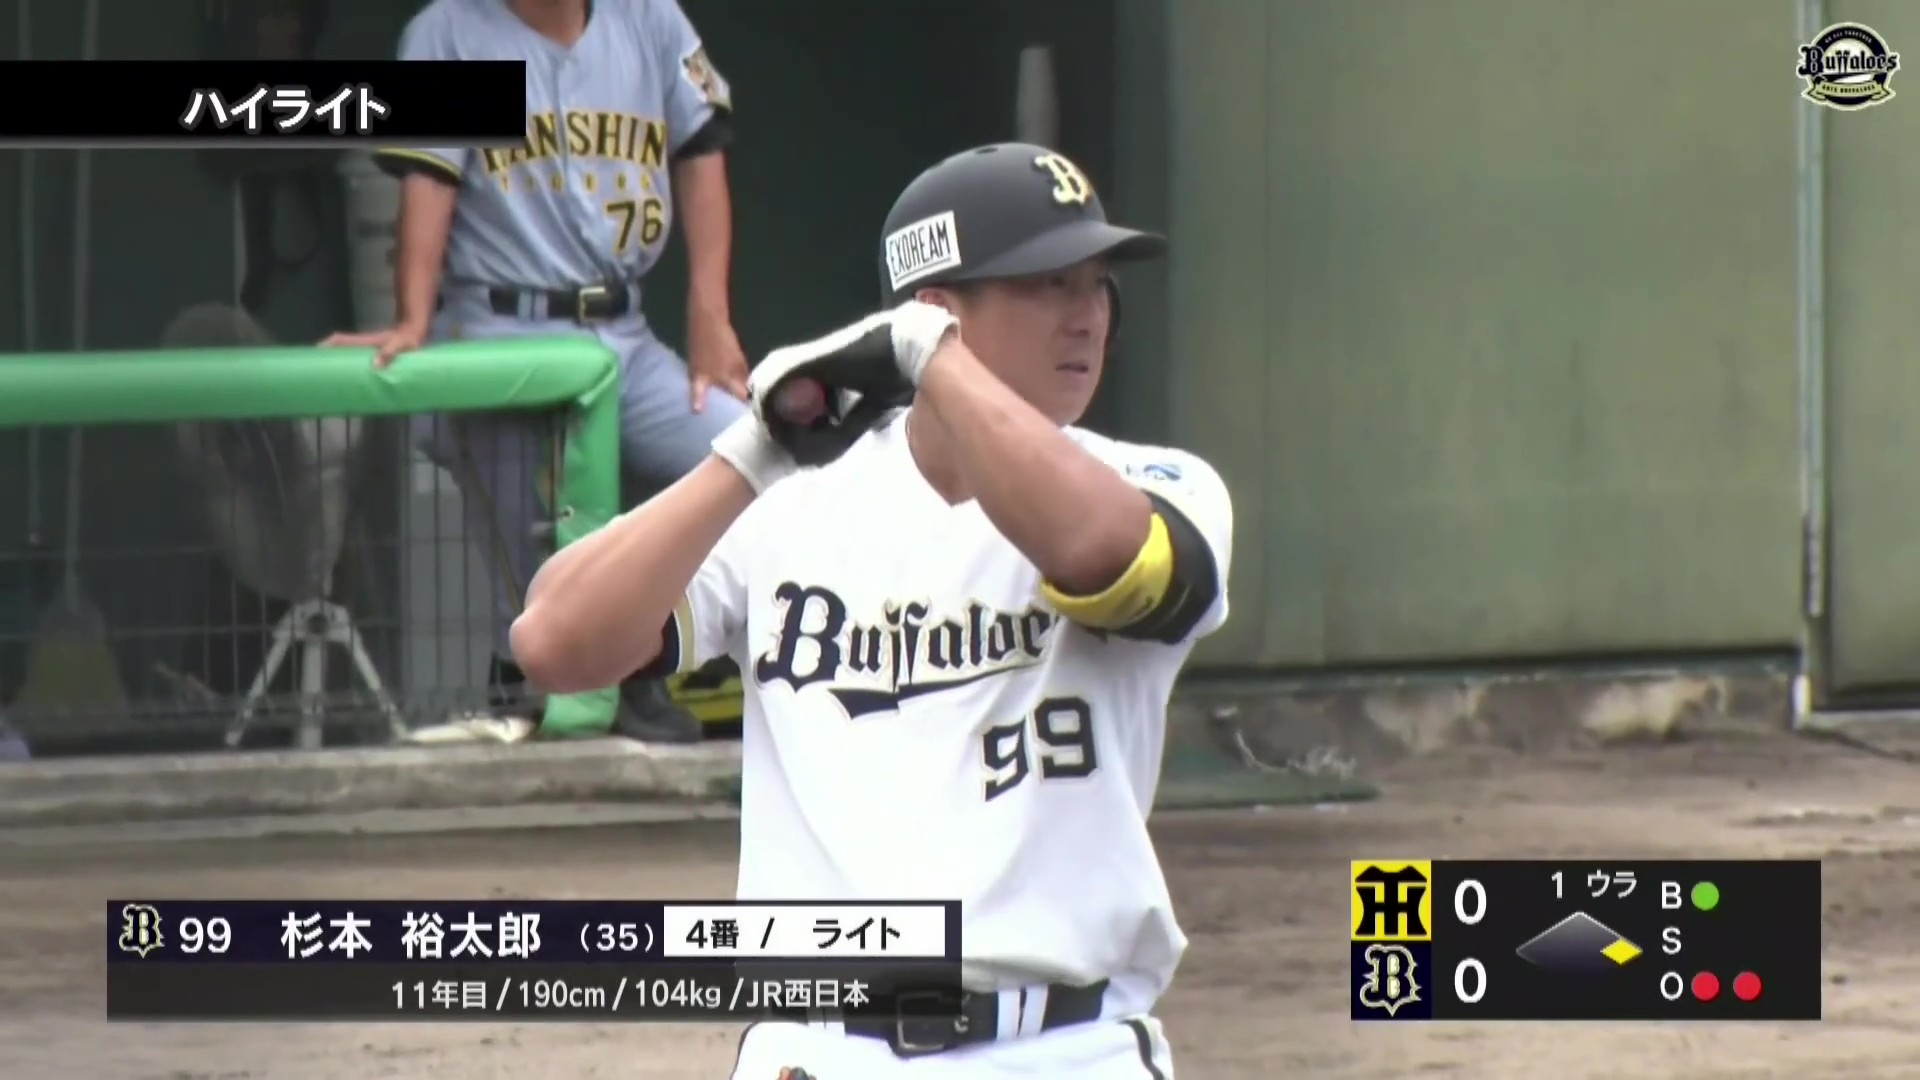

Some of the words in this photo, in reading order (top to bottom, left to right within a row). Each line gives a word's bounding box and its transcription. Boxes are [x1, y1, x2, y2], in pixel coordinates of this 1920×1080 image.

[1032, 153, 1093, 206] B
[605, 198, 664, 253] 76
[755, 578, 1060, 696] Buffaloe
[980, 696, 1098, 803] 99
